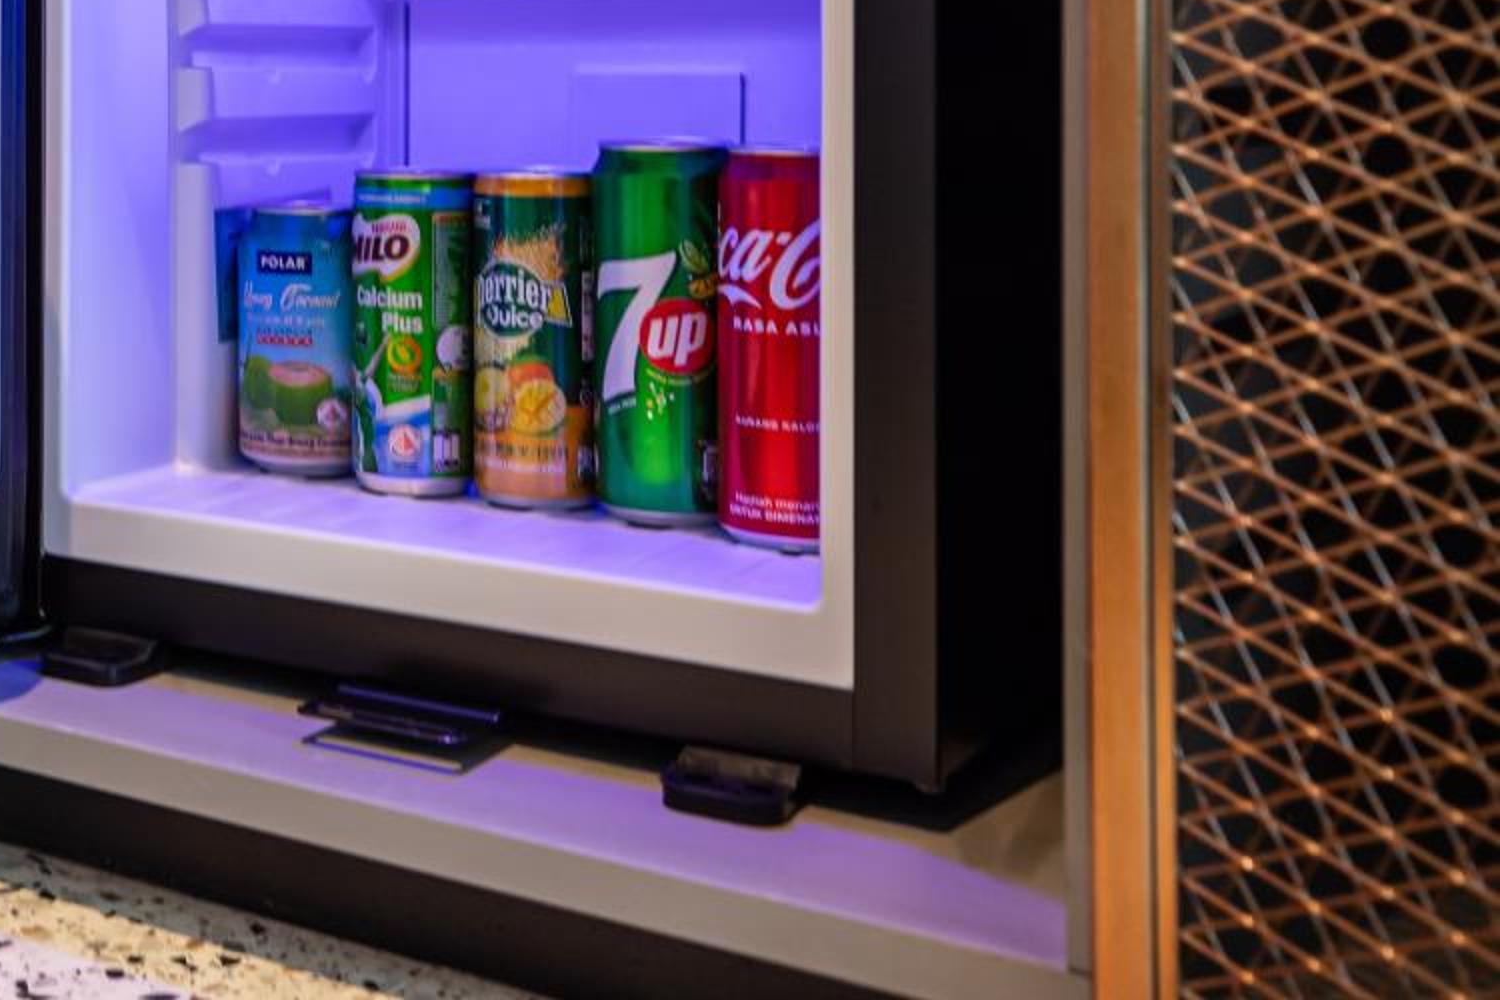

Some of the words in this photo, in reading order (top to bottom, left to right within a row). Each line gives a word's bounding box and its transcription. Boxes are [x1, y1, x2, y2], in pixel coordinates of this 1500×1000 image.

[260, 255, 306, 271] POLAR
[357, 284, 423, 309] Calcium
[381, 311, 423, 333] Plus
